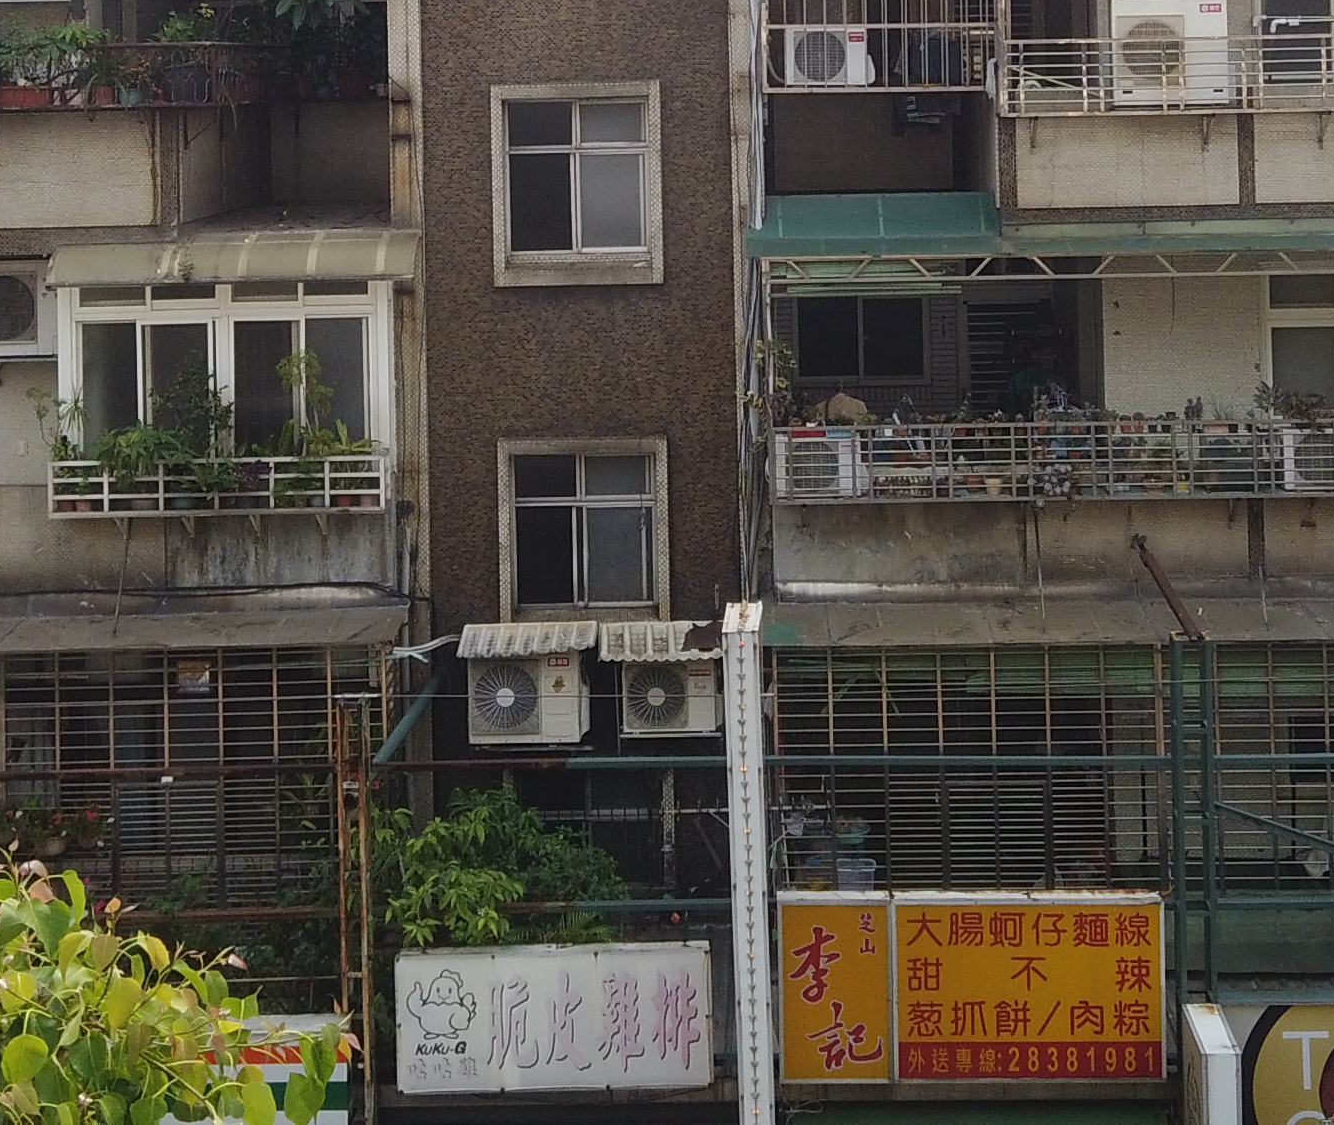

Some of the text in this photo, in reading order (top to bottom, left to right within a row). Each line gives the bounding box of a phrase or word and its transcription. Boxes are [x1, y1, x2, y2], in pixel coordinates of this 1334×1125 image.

[858, 911, 877, 955] 芝山
[906, 911, 1152, 948] 大腸蚵仔麵線
[788, 924, 884, 1072] 李記
